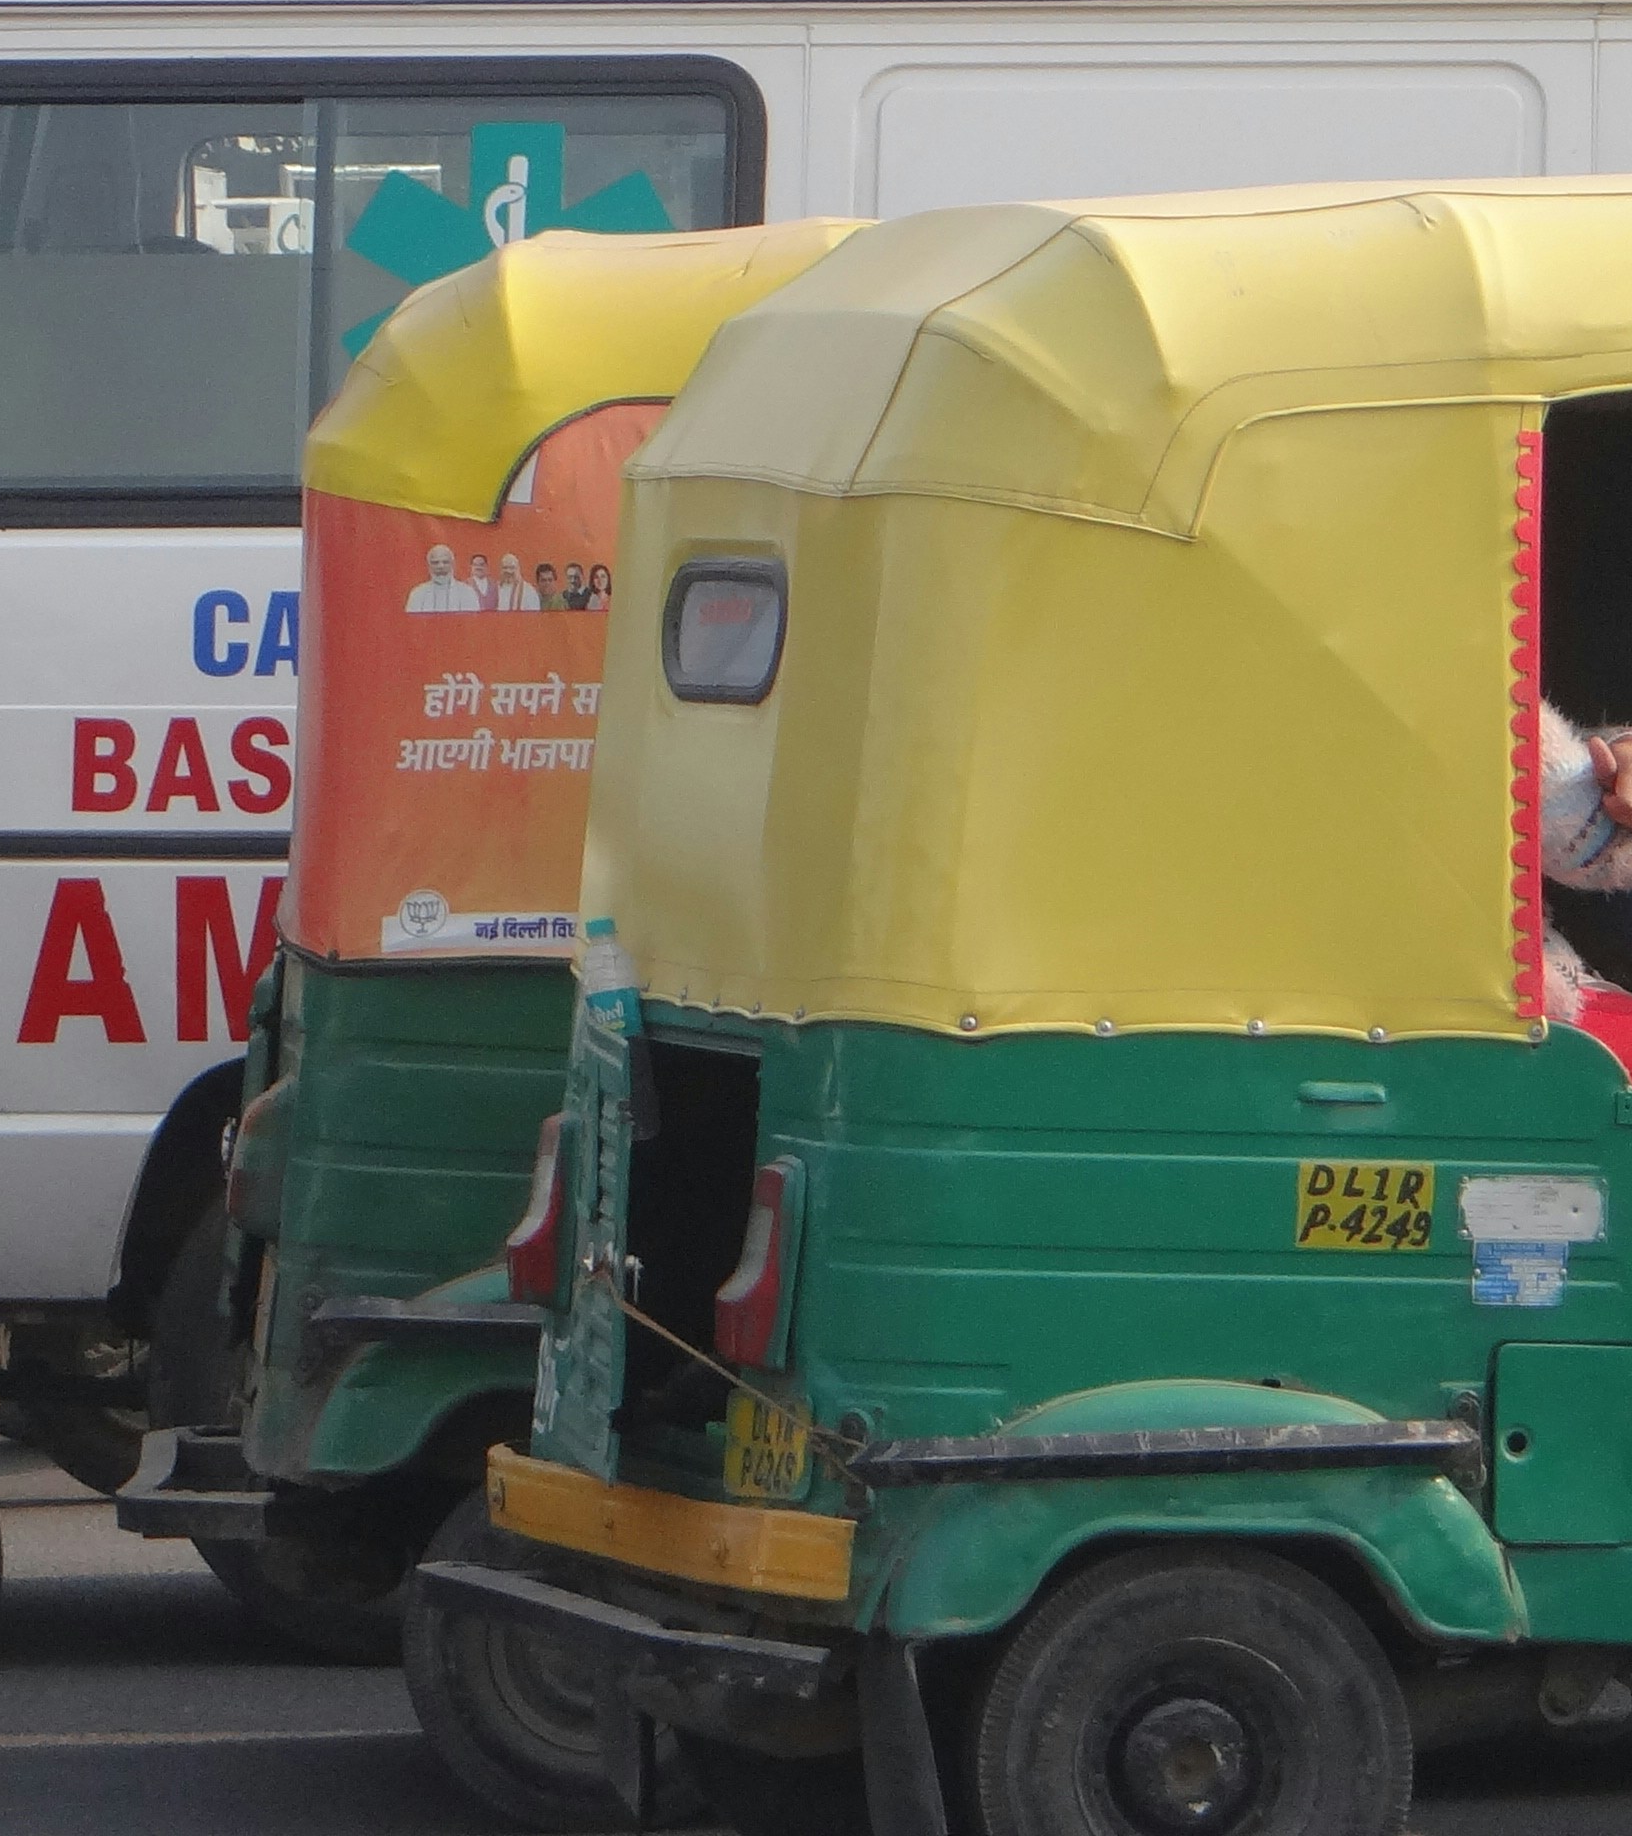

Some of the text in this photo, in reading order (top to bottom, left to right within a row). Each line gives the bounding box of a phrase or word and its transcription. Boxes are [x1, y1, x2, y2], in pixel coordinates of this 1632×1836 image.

[192, 588, 300, 678] CA
[423, 671, 485, 718] होंगे
[489, 671, 566, 715] सपने
[71, 716, 293, 814] BAS
[395, 727, 596, 770] आएगी भाजपा
[473, 916, 499, 941] नई
[502, 916, 549, 939] दिल्ली
[1306, 1163, 1426, 1210] DL1R
